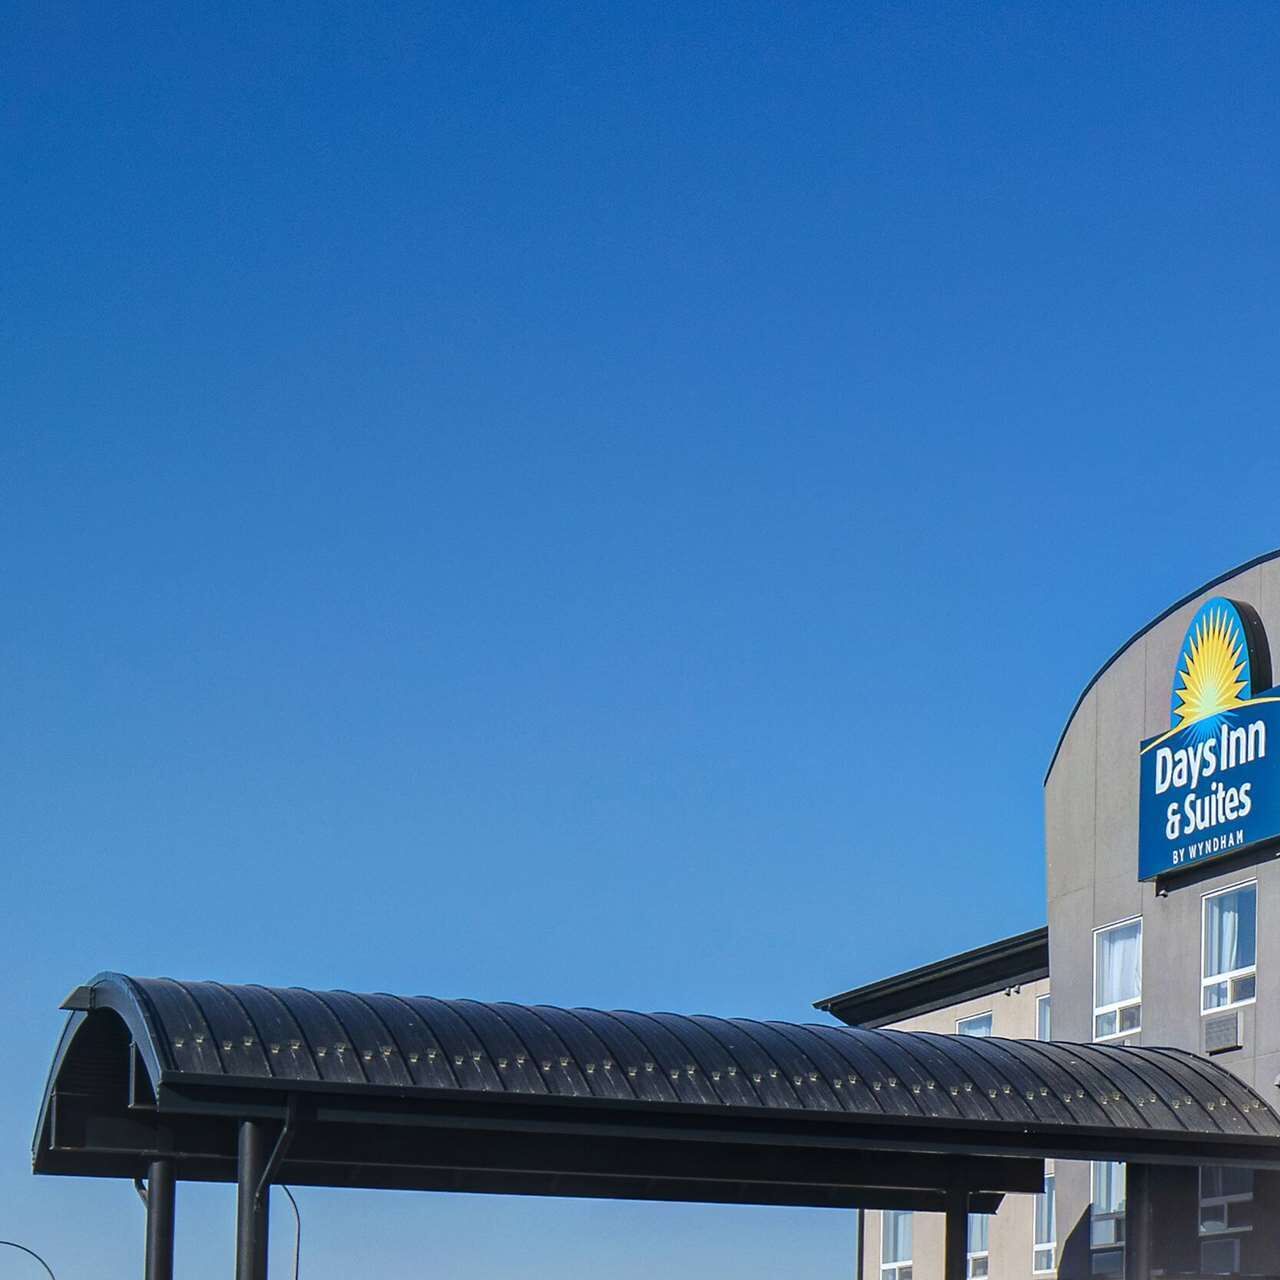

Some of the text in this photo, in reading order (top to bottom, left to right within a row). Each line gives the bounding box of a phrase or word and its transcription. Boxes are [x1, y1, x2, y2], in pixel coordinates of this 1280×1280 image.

[1155, 720, 1266, 795] Days Inn
[1165, 781, 1251, 840] & Suites
[1172, 829, 1244, 865] BY WYNDHAM
